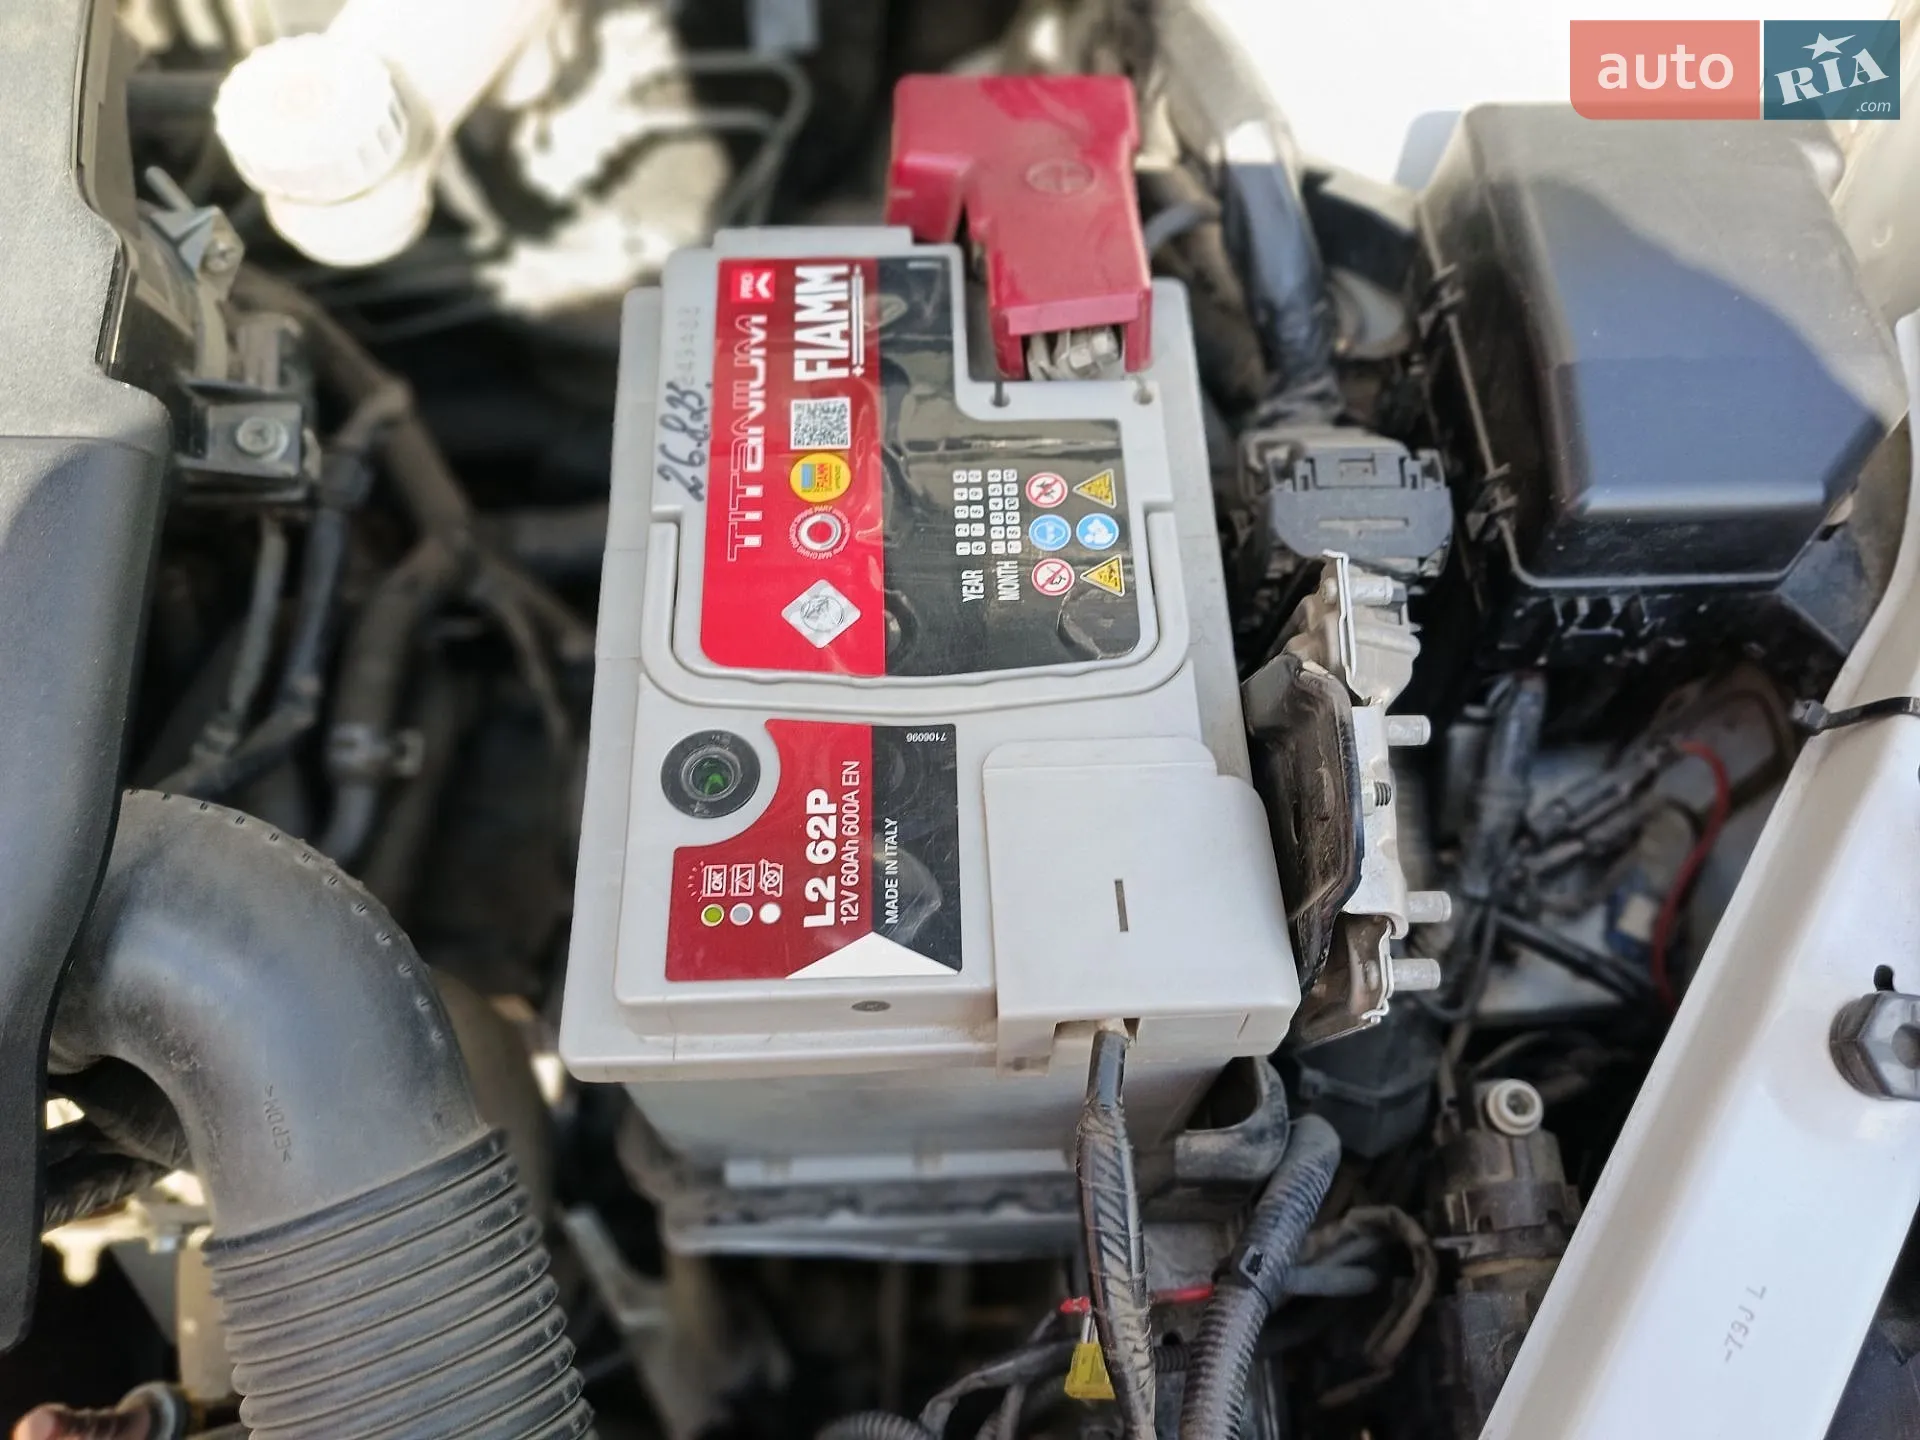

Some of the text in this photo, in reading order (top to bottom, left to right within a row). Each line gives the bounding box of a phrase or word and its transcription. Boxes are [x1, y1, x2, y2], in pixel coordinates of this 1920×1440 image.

[794, 264, 849, 381] FIAMM
[961, 569, 984, 602] YEAR
[996, 561, 1020, 600] MONTH
[803, 788, 837, 928] L2 62P
[841, 760, 861, 925] 12V 60Ah 600A EN
[884, 817, 898, 924] MADE IN ITALY
